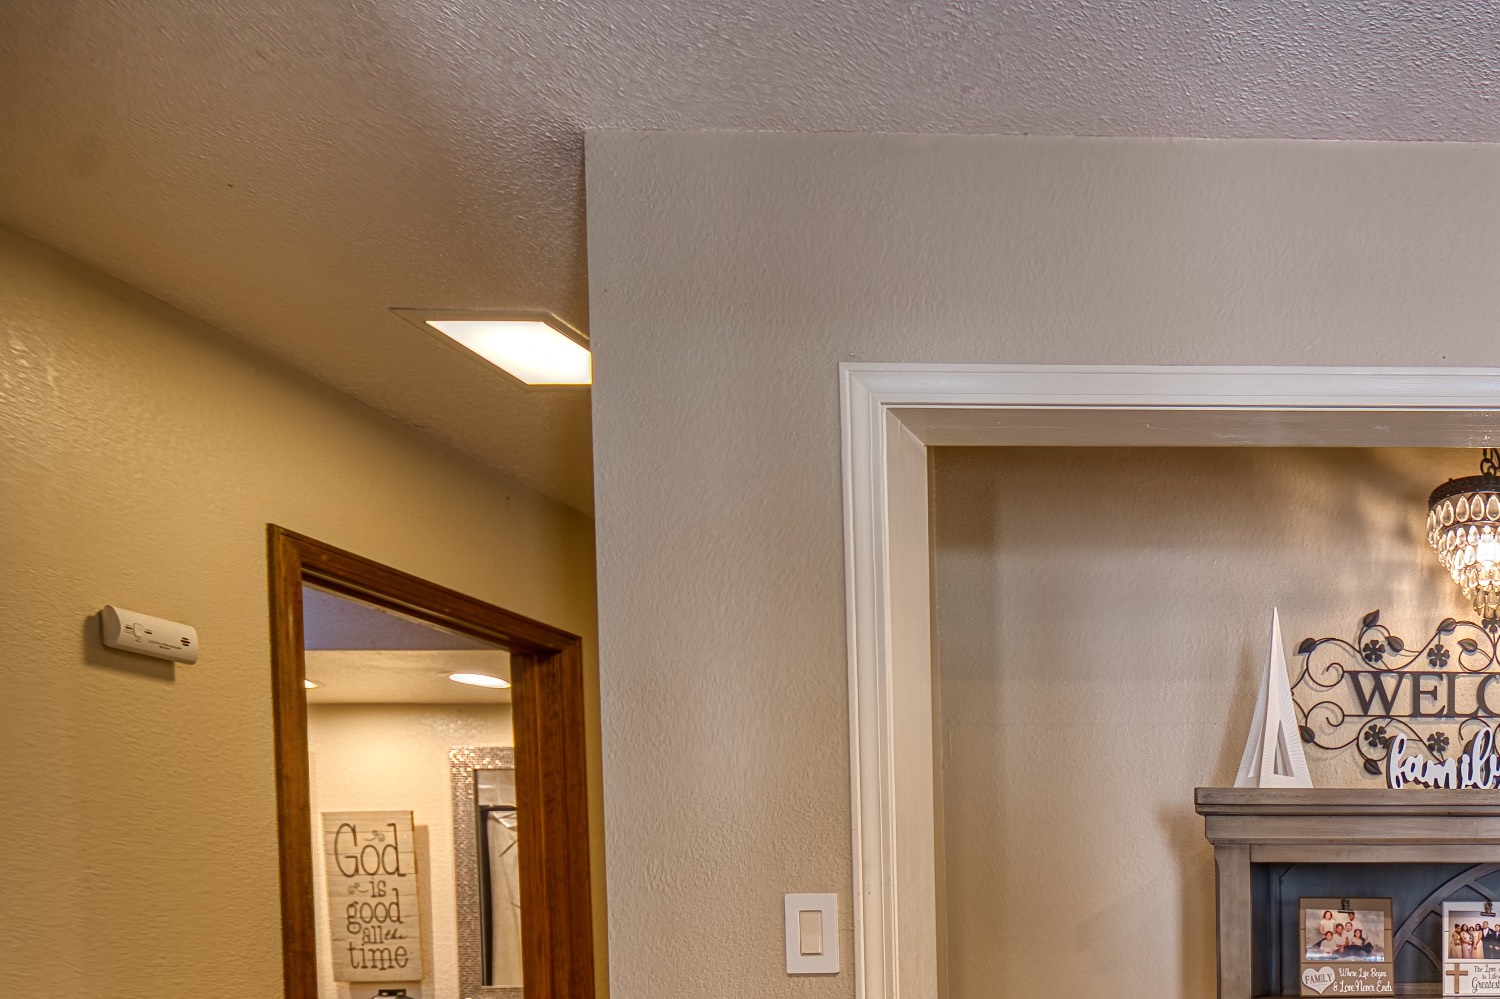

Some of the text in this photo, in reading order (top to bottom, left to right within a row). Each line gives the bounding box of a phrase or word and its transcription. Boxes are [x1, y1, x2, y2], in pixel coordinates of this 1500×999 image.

[334, 823, 407, 878] God
[371, 877, 387, 898] is
[346, 888, 405, 935] good
[362, 925, 384, 945] all
[347, 941, 409, 971] time
[1474, 965, 1483, 973] The
[1485, 964, 1497, 973] Love
[1305, 973, 1332, 985] FAMILY
[1339, 980, 1355, 993] Love
[1355, 980, 1375, 992] Never
[1376, 980, 1393, 993] Ends
[1471, 976, 1500, 993] Greatest
